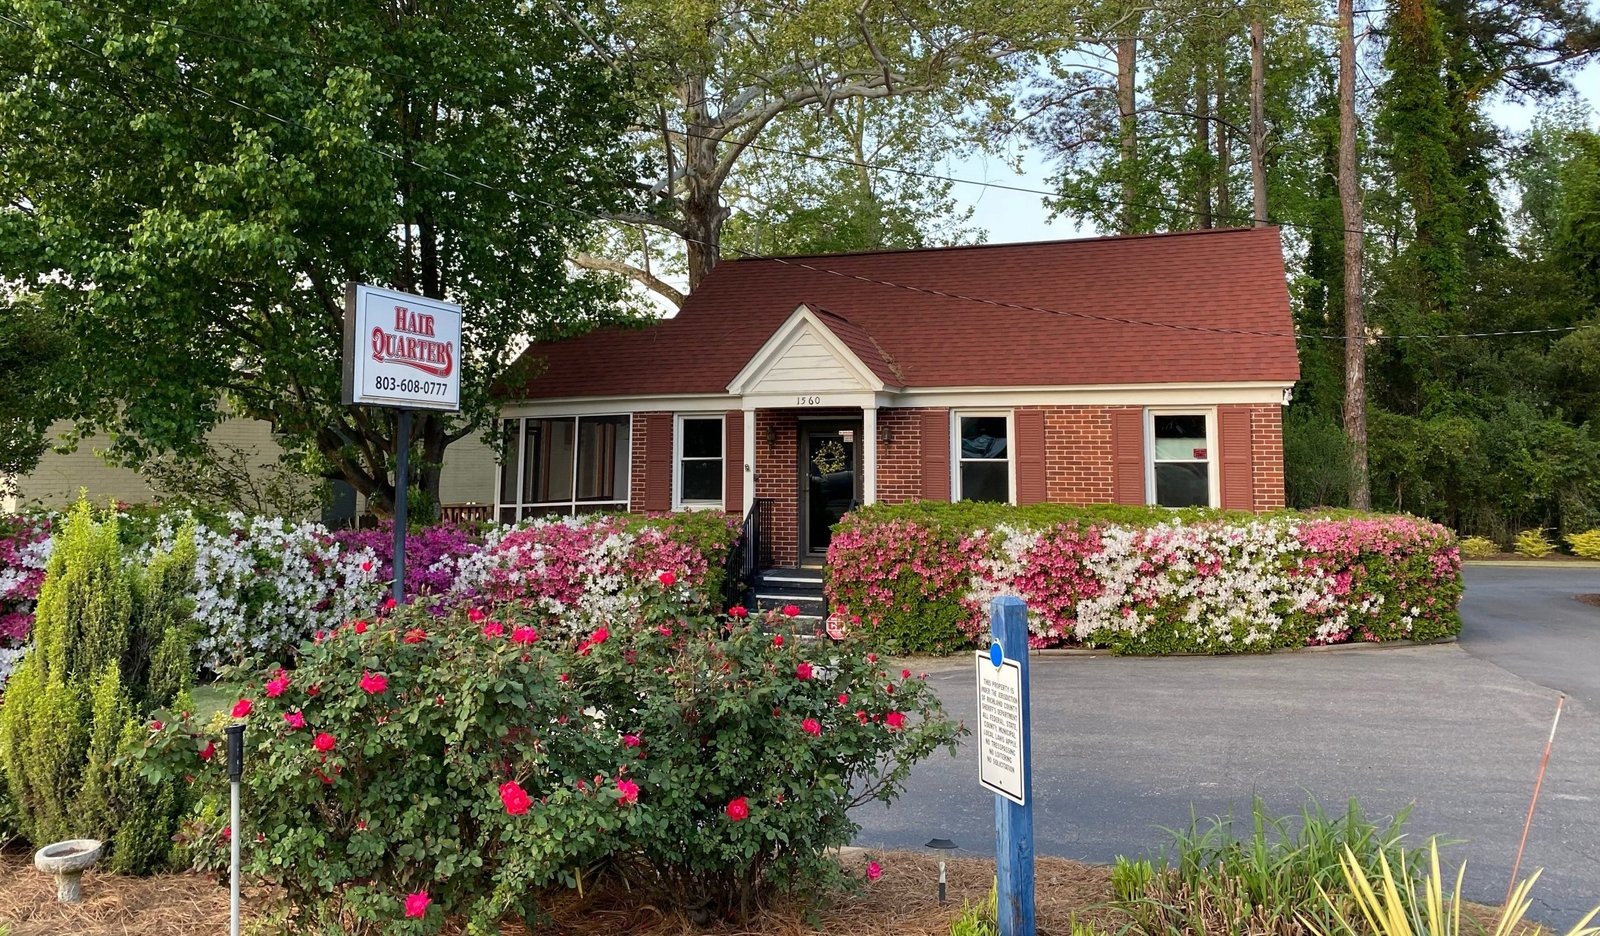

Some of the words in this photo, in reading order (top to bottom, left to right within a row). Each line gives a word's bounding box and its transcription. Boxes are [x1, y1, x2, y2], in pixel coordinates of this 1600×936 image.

[394, 305, 435, 338] HAIR
[371, 326, 453, 377] QUARTERS
[375, 376, 448, 396] 803-608-0777
[797, 396, 821, 405] 1560
[992, 681, 1009, 692] PROPERTY
[986, 696, 1003, 707] RICHLAND
[1003, 702, 1018, 712] COUNTY
